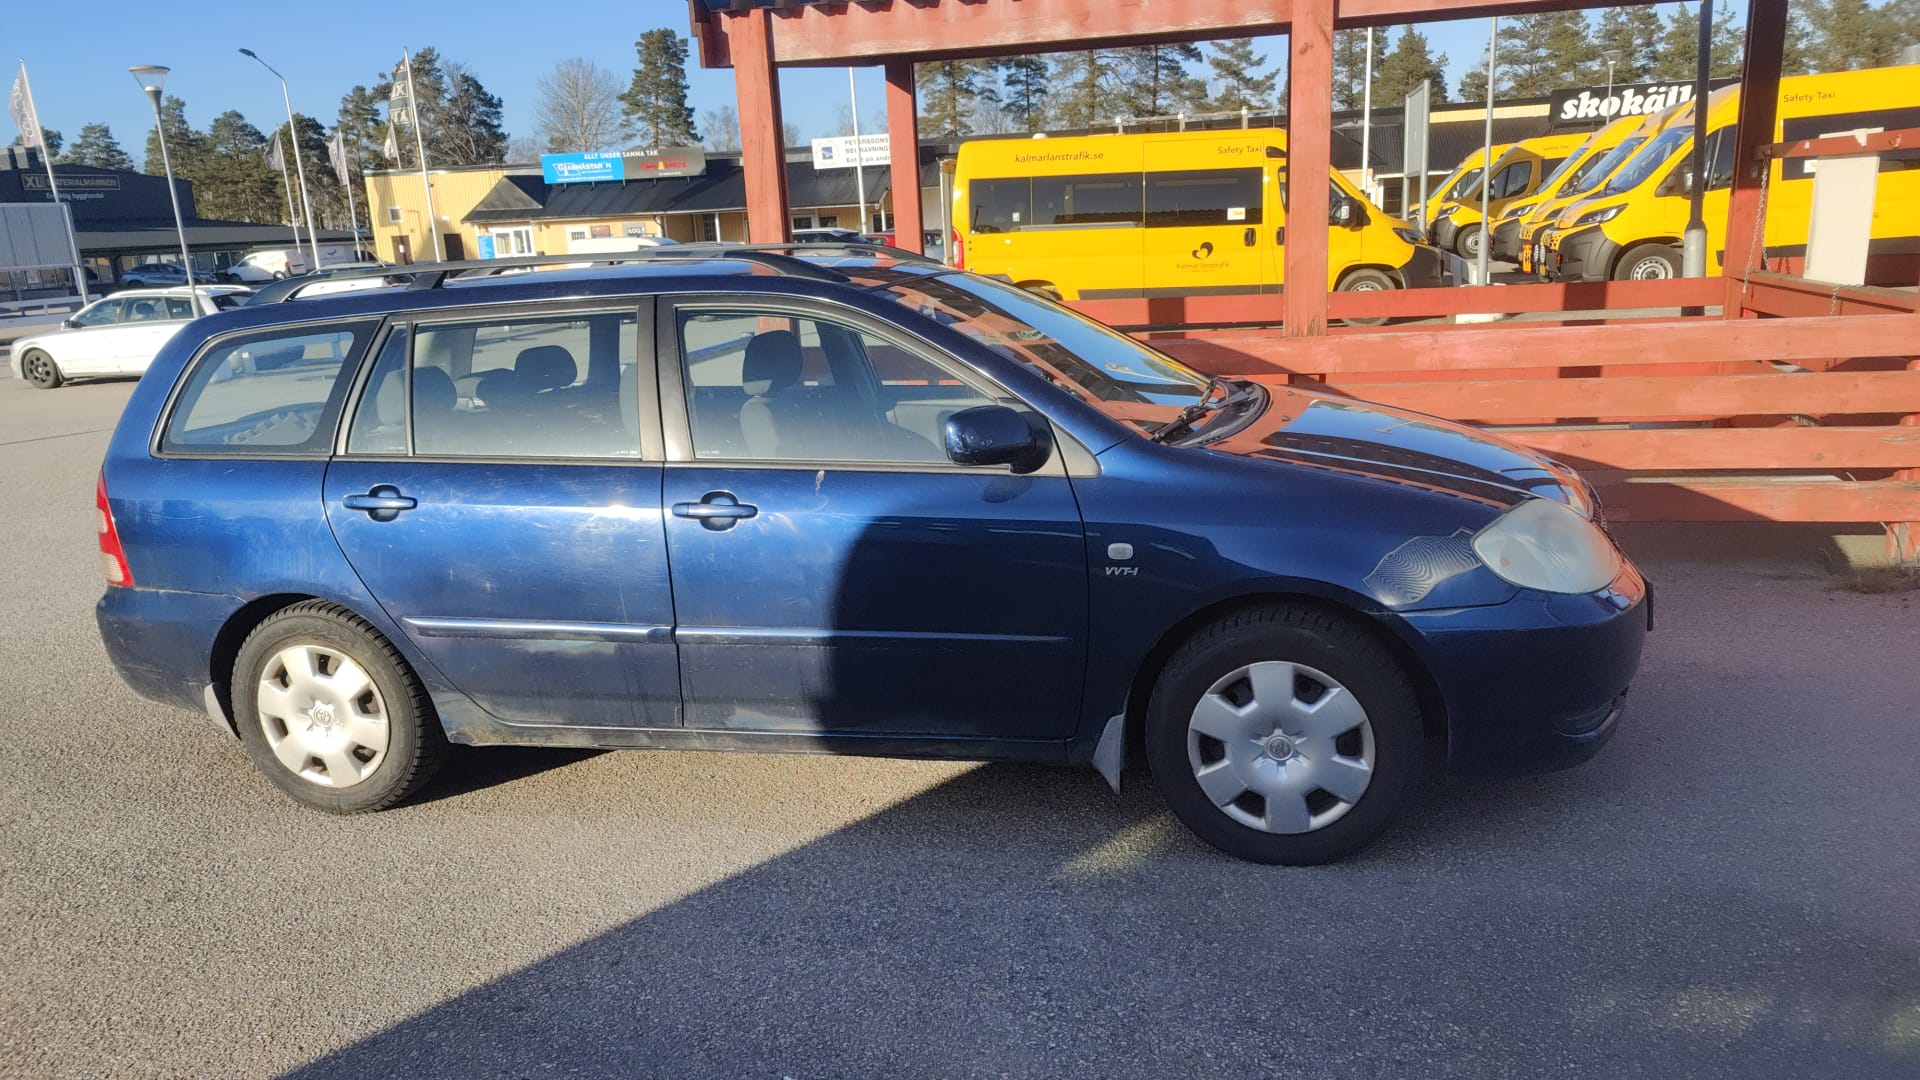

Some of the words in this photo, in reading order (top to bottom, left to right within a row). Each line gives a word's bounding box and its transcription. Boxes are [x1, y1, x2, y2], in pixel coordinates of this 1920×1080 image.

[1783, 93, 1813, 102] Safety
[1816, 91, 1836, 99] Taxi
[1217, 146, 1243, 155] Safety
[1015, 151, 1104, 163] kalmarlanstrafik.se
